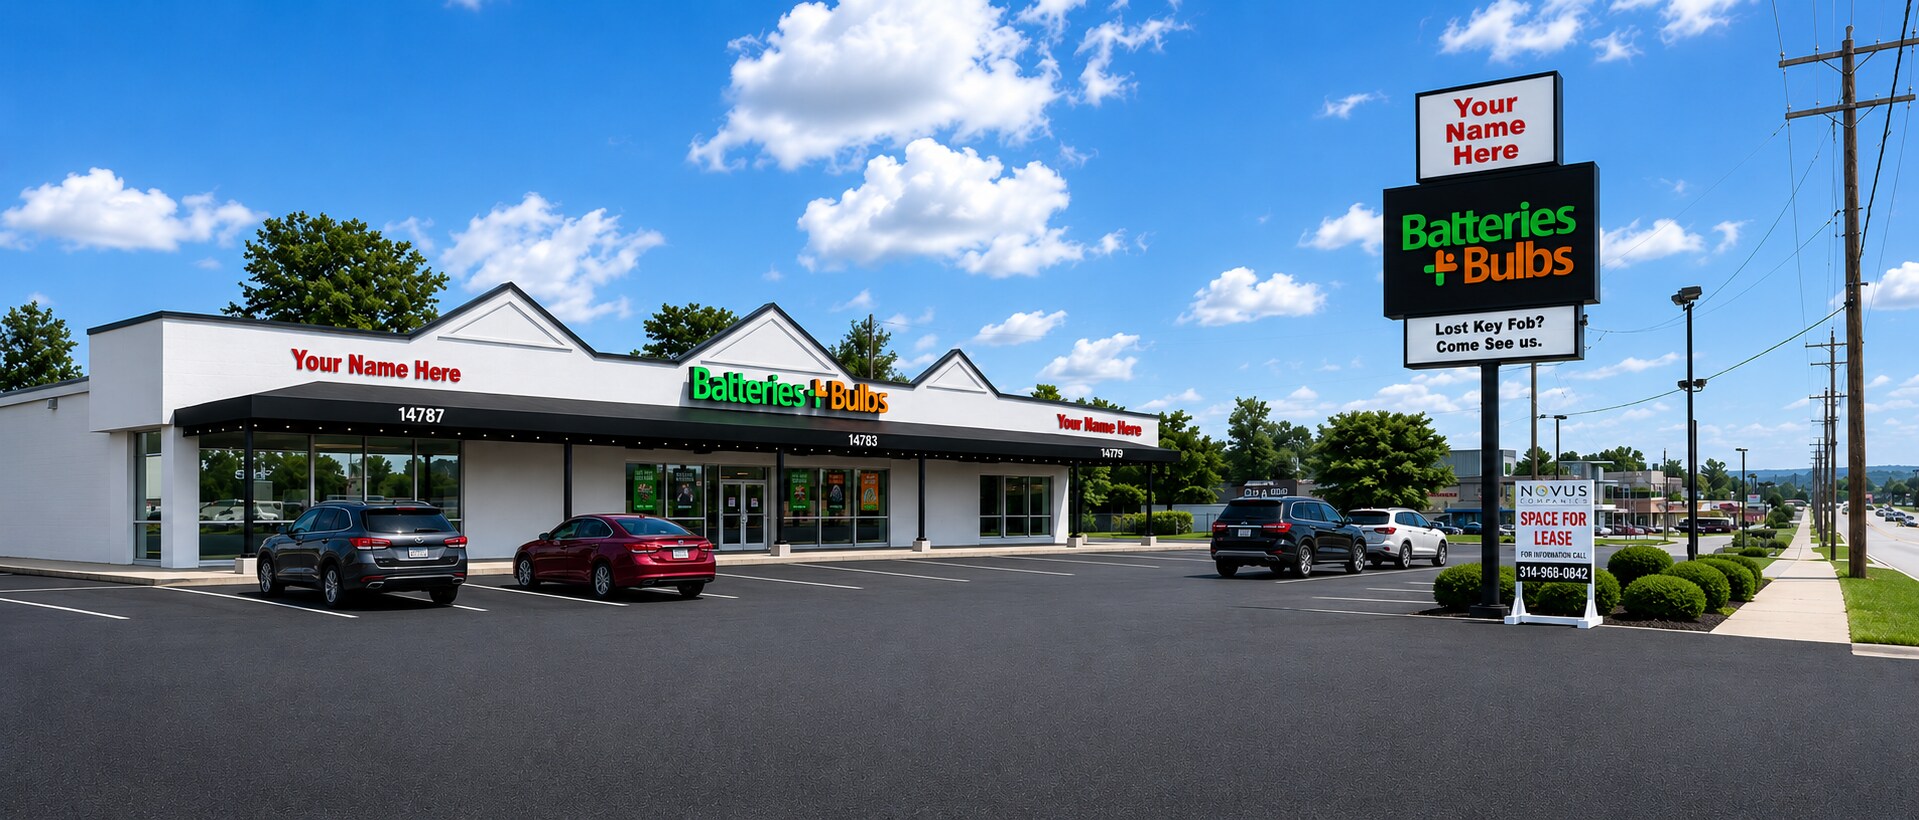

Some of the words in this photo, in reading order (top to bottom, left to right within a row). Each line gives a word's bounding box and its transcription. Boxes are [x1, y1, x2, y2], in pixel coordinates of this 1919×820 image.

[1453, 96, 1518, 118] Your
[1446, 117, 1526, 143] Name
[1453, 143, 1519, 166] Here
[1402, 201, 1577, 251] Batteries
[1463, 240, 1574, 284] Bulbs
[1435, 321, 1468, 336] Lost
[1473, 319, 1502, 335] Key
[1508, 315, 1545, 331] Fob?
[1436, 339, 1479, 353] Come
[1485, 336, 1514, 350] See
[1519, 336, 1543, 348] us.
[291, 348, 342, 373] Your
[348, 354, 408, 379] Name
[414, 360, 461, 383] Here
[690, 366, 805, 408] Batteries
[828, 380, 889, 414] Bulbs
[398, 407, 445, 423] 14787
[1057, 413, 1082, 431] Your
[1084, 416, 1116, 434] Name
[1117, 420, 1142, 437] Here
[848, 434, 878, 447] 14783
[1101, 448, 1123, 459] 14779
[1520, 485, 1587, 497] NOVUS
[1520, 511, 1558, 526] SPACE
[1562, 512, 1587, 527] FOR
[1534, 531, 1572, 546] LEASE
[1519, 566, 1588, 579] 314-968-0842
